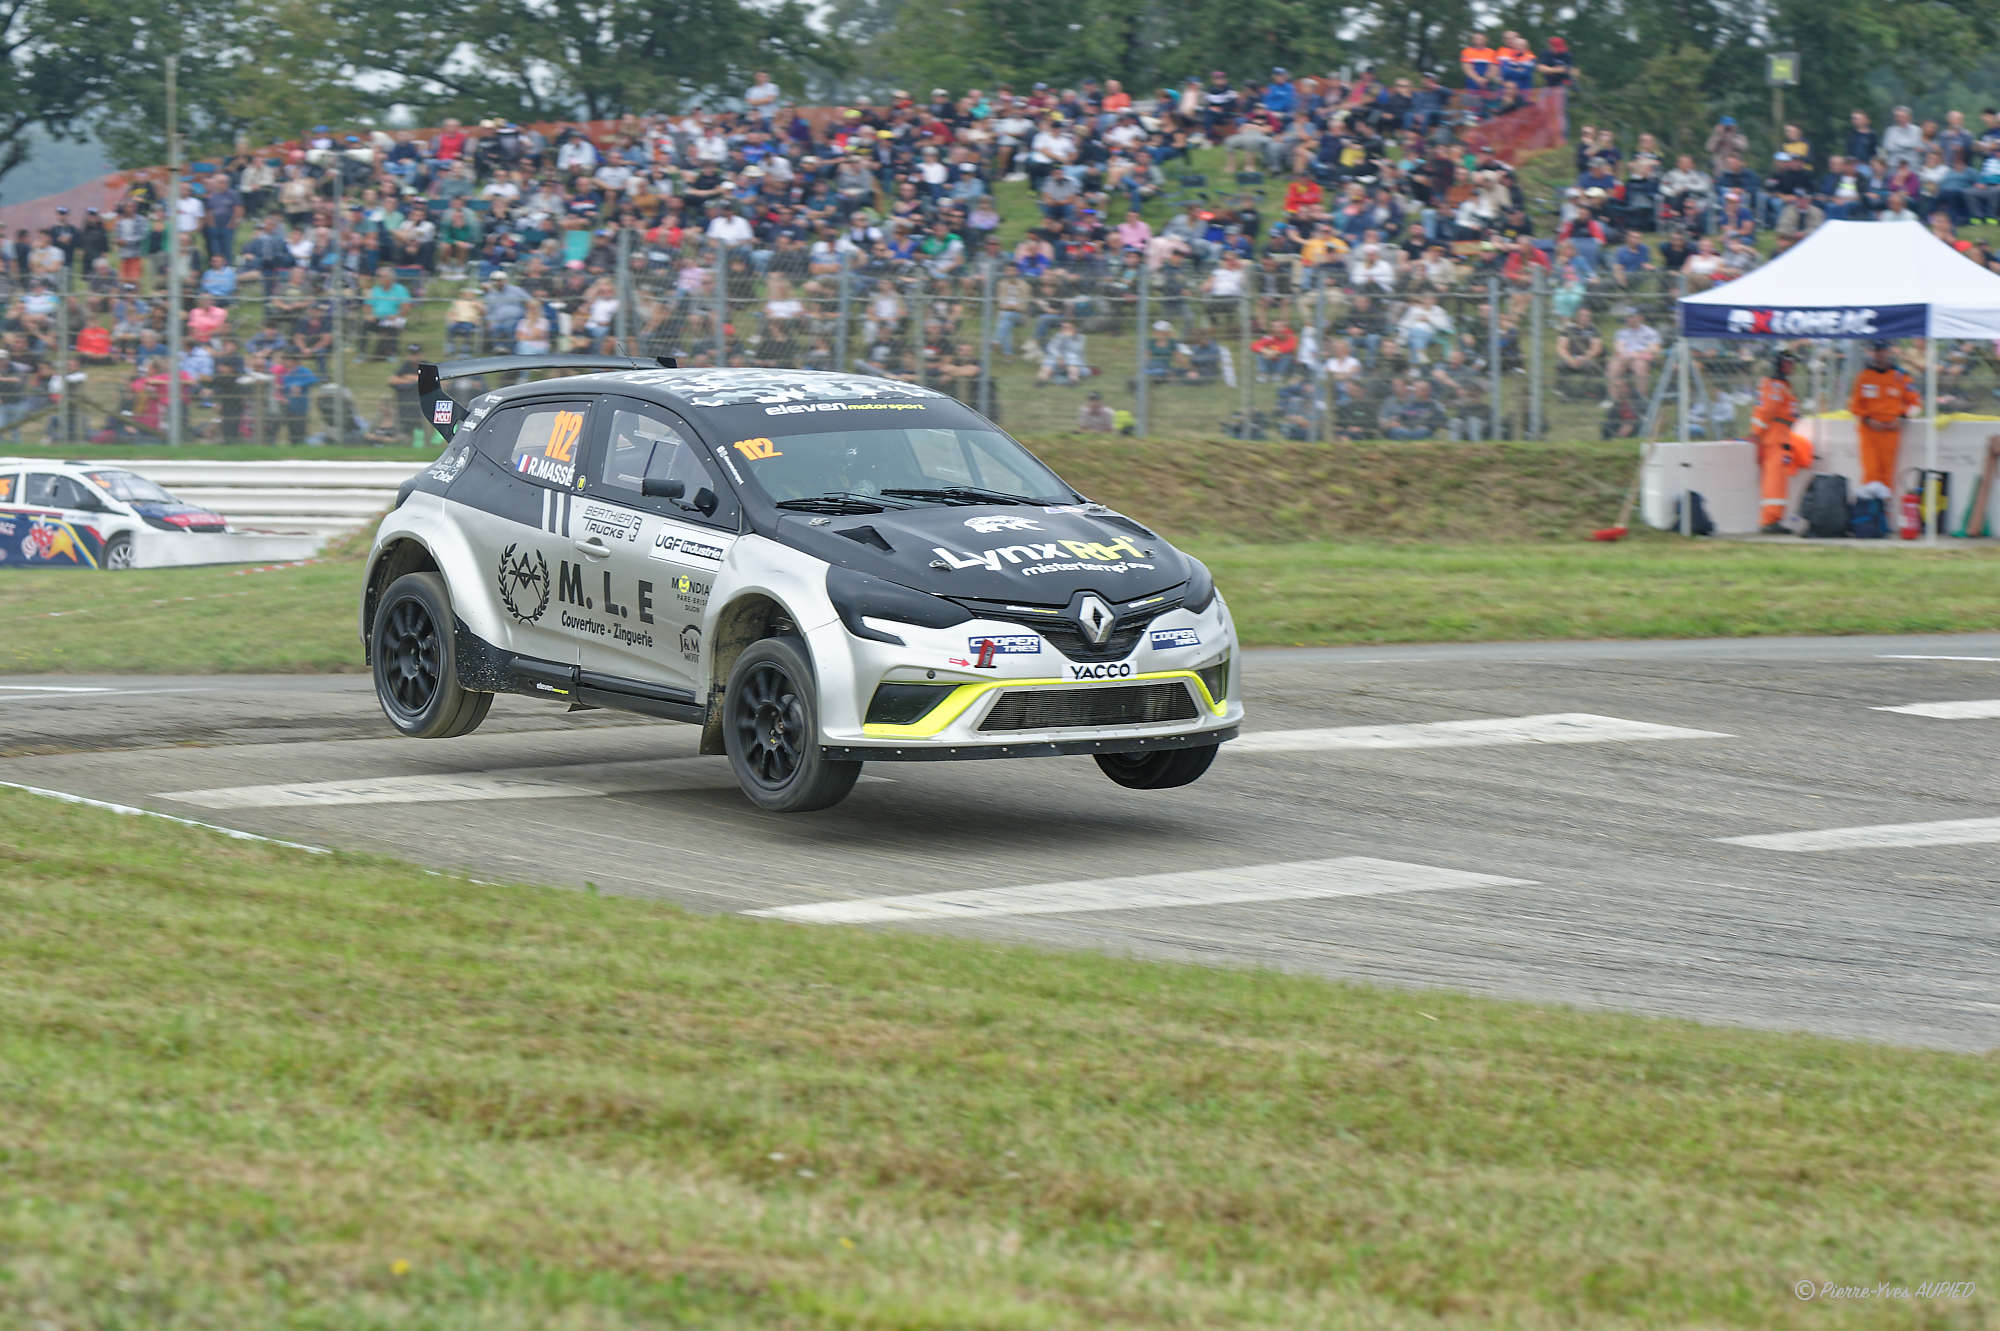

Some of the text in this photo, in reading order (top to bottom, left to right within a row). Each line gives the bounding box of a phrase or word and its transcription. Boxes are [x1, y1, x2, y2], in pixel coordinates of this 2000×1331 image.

[545, 410, 584, 462] 112
[733, 437, 783, 461] 112
[584, 505, 633, 525] BERTHIER
[655, 534, 683, 551] UGF
[561, 610, 605, 635] Couverture
[613, 622, 653, 647] Zinguerie
[1151, 629, 1195, 642] COOPER
[970, 636, 1039, 647] COPER
[1004, 645, 1039, 653] TIRES
[1070, 663, 1131, 681] YACCO
